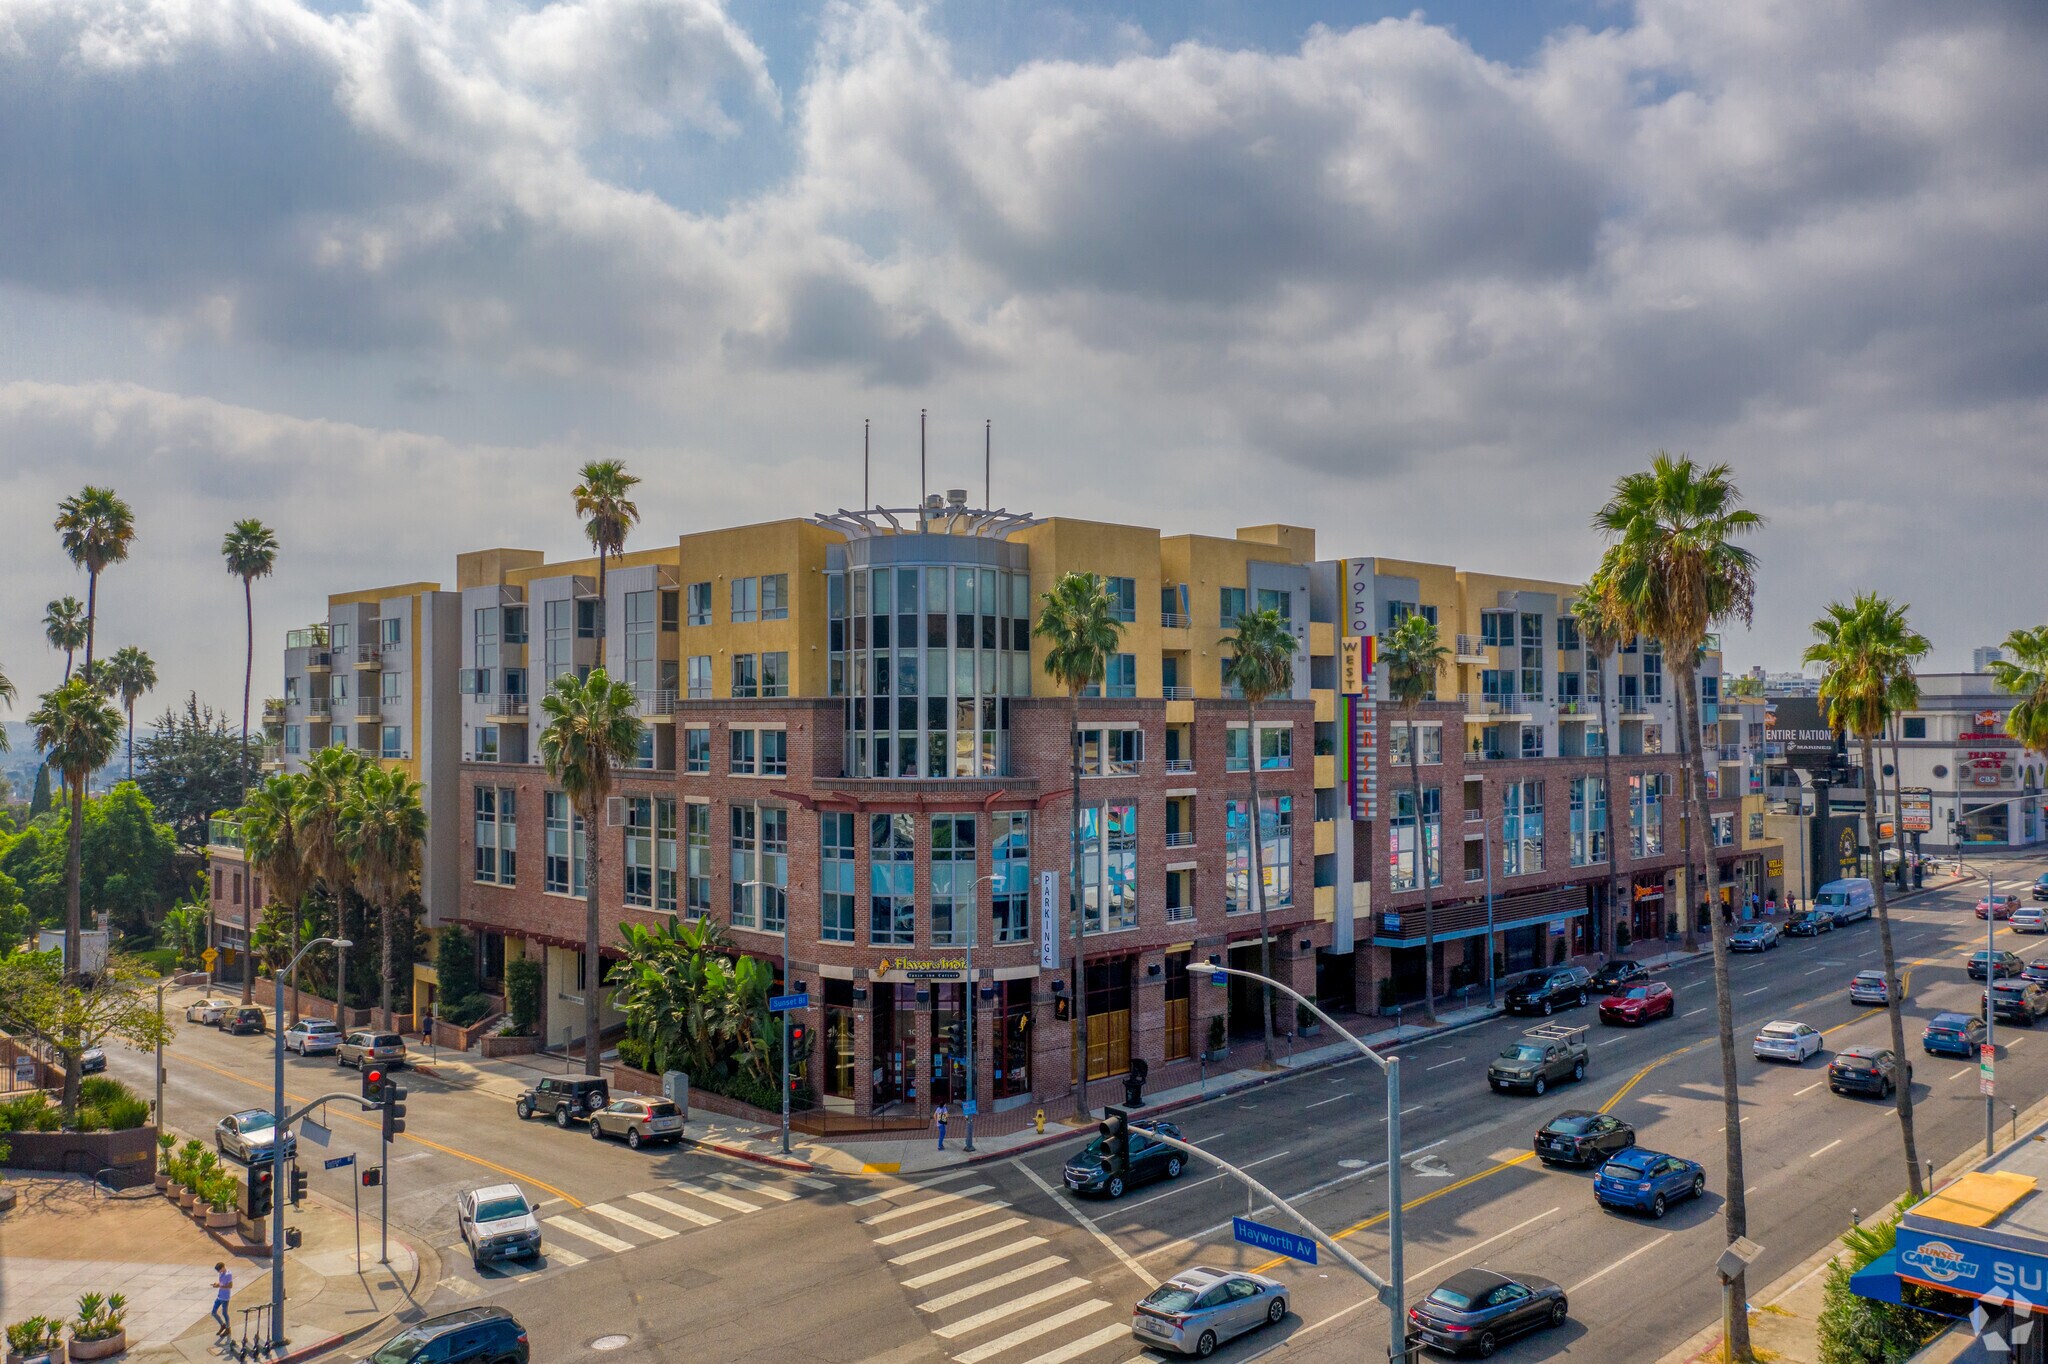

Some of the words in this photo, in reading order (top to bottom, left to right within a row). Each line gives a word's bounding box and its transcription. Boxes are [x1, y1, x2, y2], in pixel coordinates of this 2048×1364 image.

[1353, 563, 1367, 631] 7950
[1343, 642, 1357, 689] WEST
[1766, 729, 1797, 740] ENTIRE
[1798, 729, 1832, 740] NATION
[1967, 752, 2007, 760] TRADER
[1973, 760, 2002, 769] JOE'S
[1979, 775, 1996, 783] CB2
[895, 956, 933, 970] Flavor
[773, 998, 797, 1008] Sunset
[1238, 1223, 1293, 1251] Hayworth
[1297, 1241, 1311, 1256] Av
[1918, 1246, 1962, 1261] SUNSET
[1904, 1251, 1934, 1267] CAR
[1935, 1258, 1977, 1275] WASH
[1993, 1261, 2048, 1293] SU
